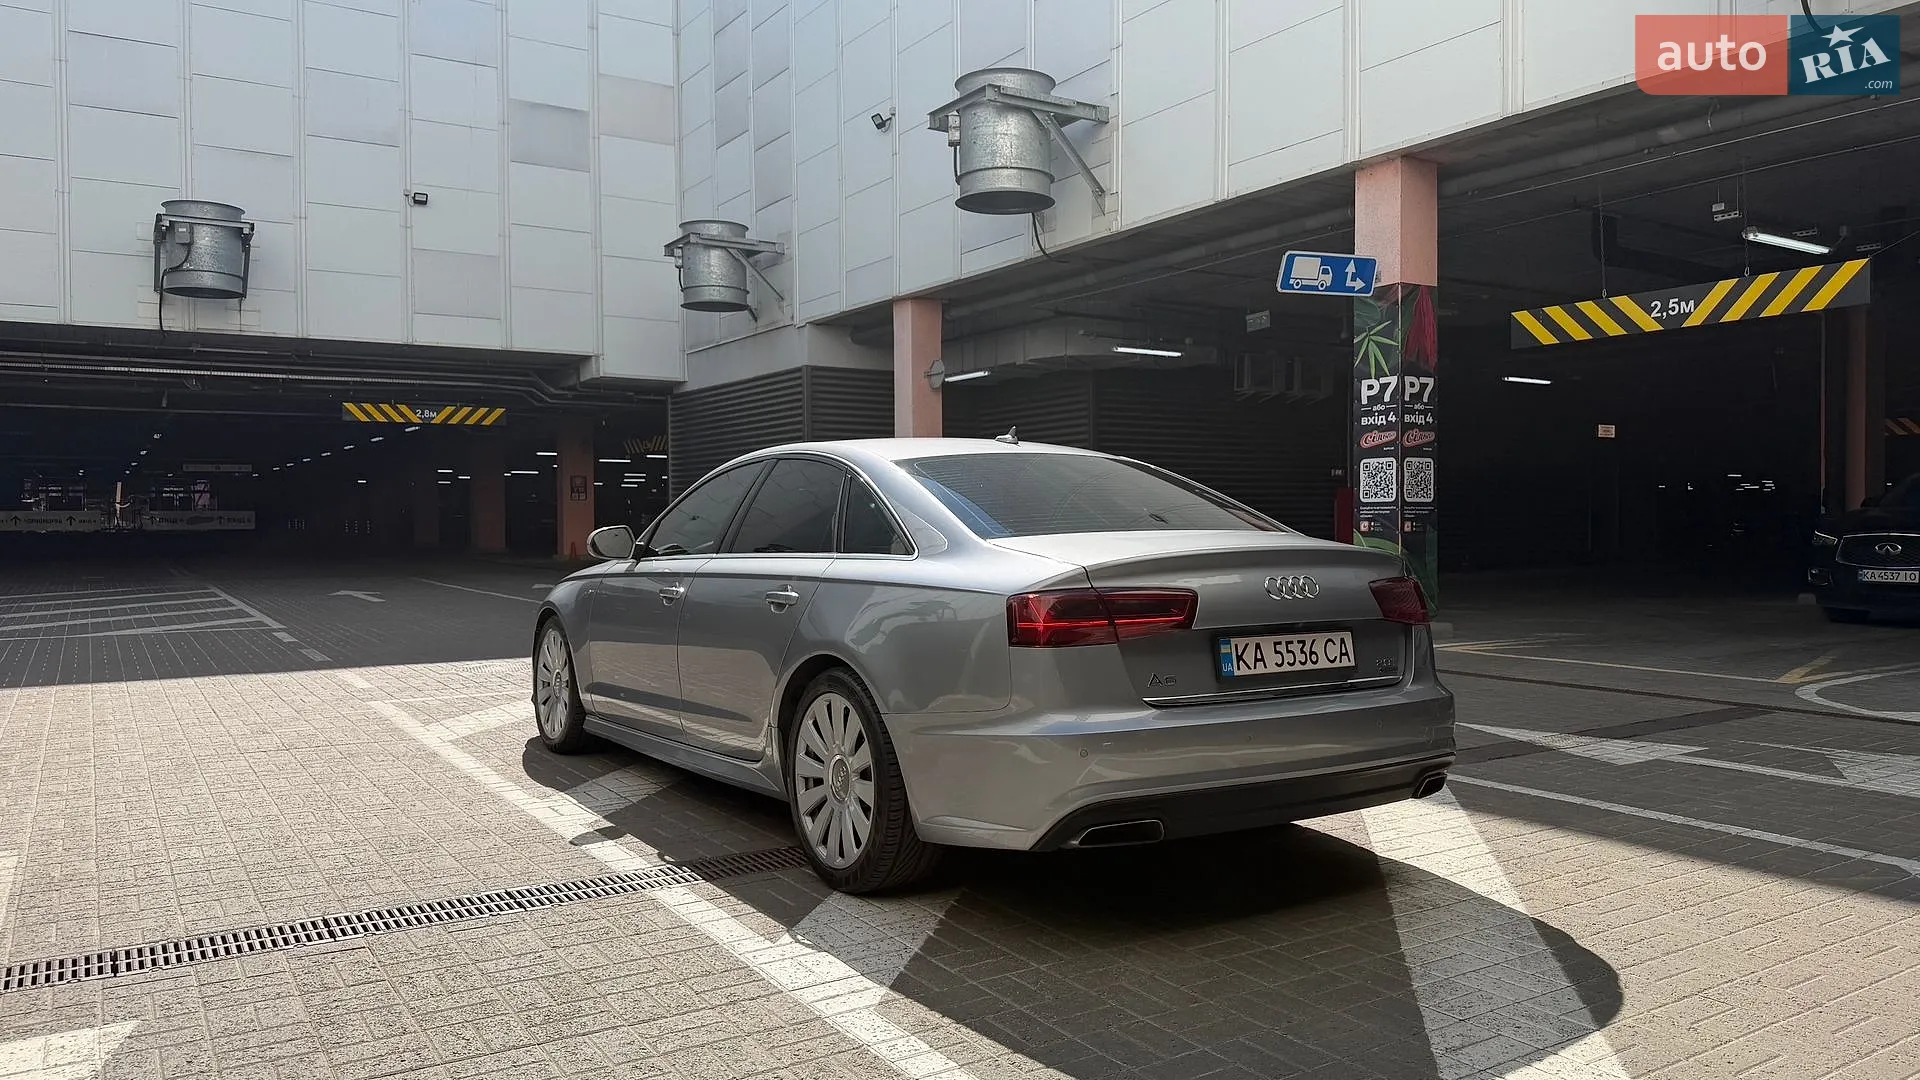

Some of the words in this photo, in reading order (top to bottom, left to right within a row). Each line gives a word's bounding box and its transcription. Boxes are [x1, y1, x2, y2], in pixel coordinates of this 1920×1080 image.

[1361, 375, 1398, 405] P7
[1404, 375, 1435, 403] P7
[1361, 412, 1386, 426] вхід
[1387, 411, 1397, 423] 4
[1404, 411, 1425, 425] вхід
[1426, 411, 1434, 424] 4
[1863, 571, 1877, 580] KA
[1878, 571, 1901, 581] 4537
[1234, 642, 1268, 672] KA
[1273, 639, 1319, 668] 5536
[1324, 637, 1352, 664] CA
[1222, 663, 1234, 673] UA
[1147, 672, 1177, 688] A6
